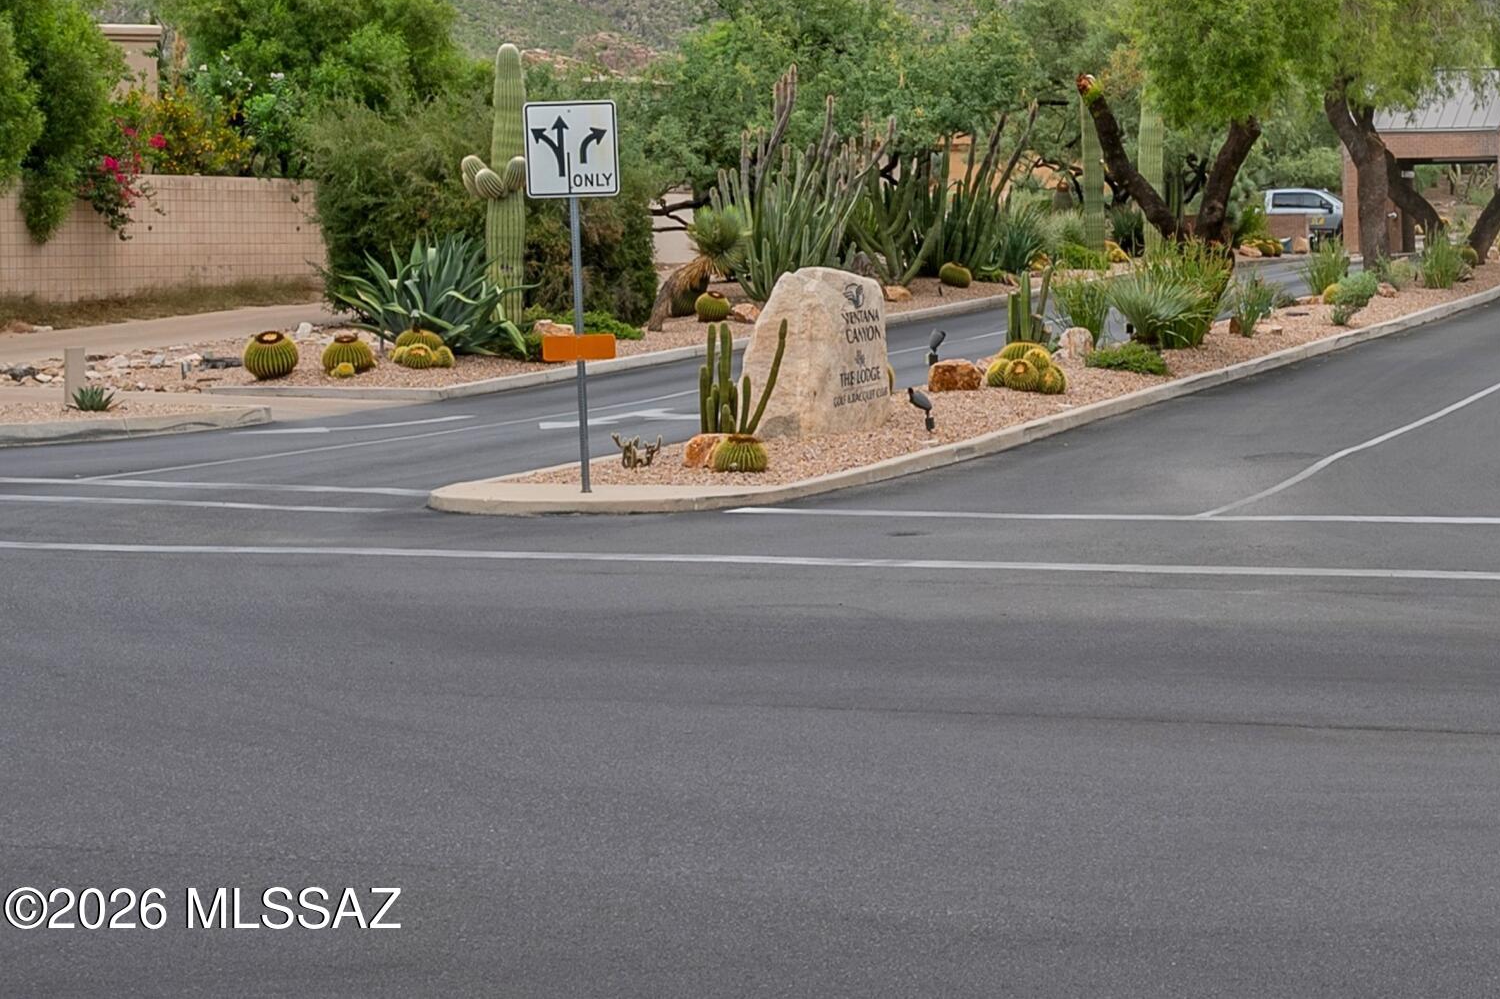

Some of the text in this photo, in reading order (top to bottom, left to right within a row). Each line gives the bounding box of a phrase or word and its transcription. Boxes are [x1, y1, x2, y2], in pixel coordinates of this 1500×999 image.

[573, 173, 612, 187] ONLY
[841, 309, 880, 324] VENTANA
[845, 325, 881, 344] CANYON
[840, 366, 881, 387] THE LODGE
